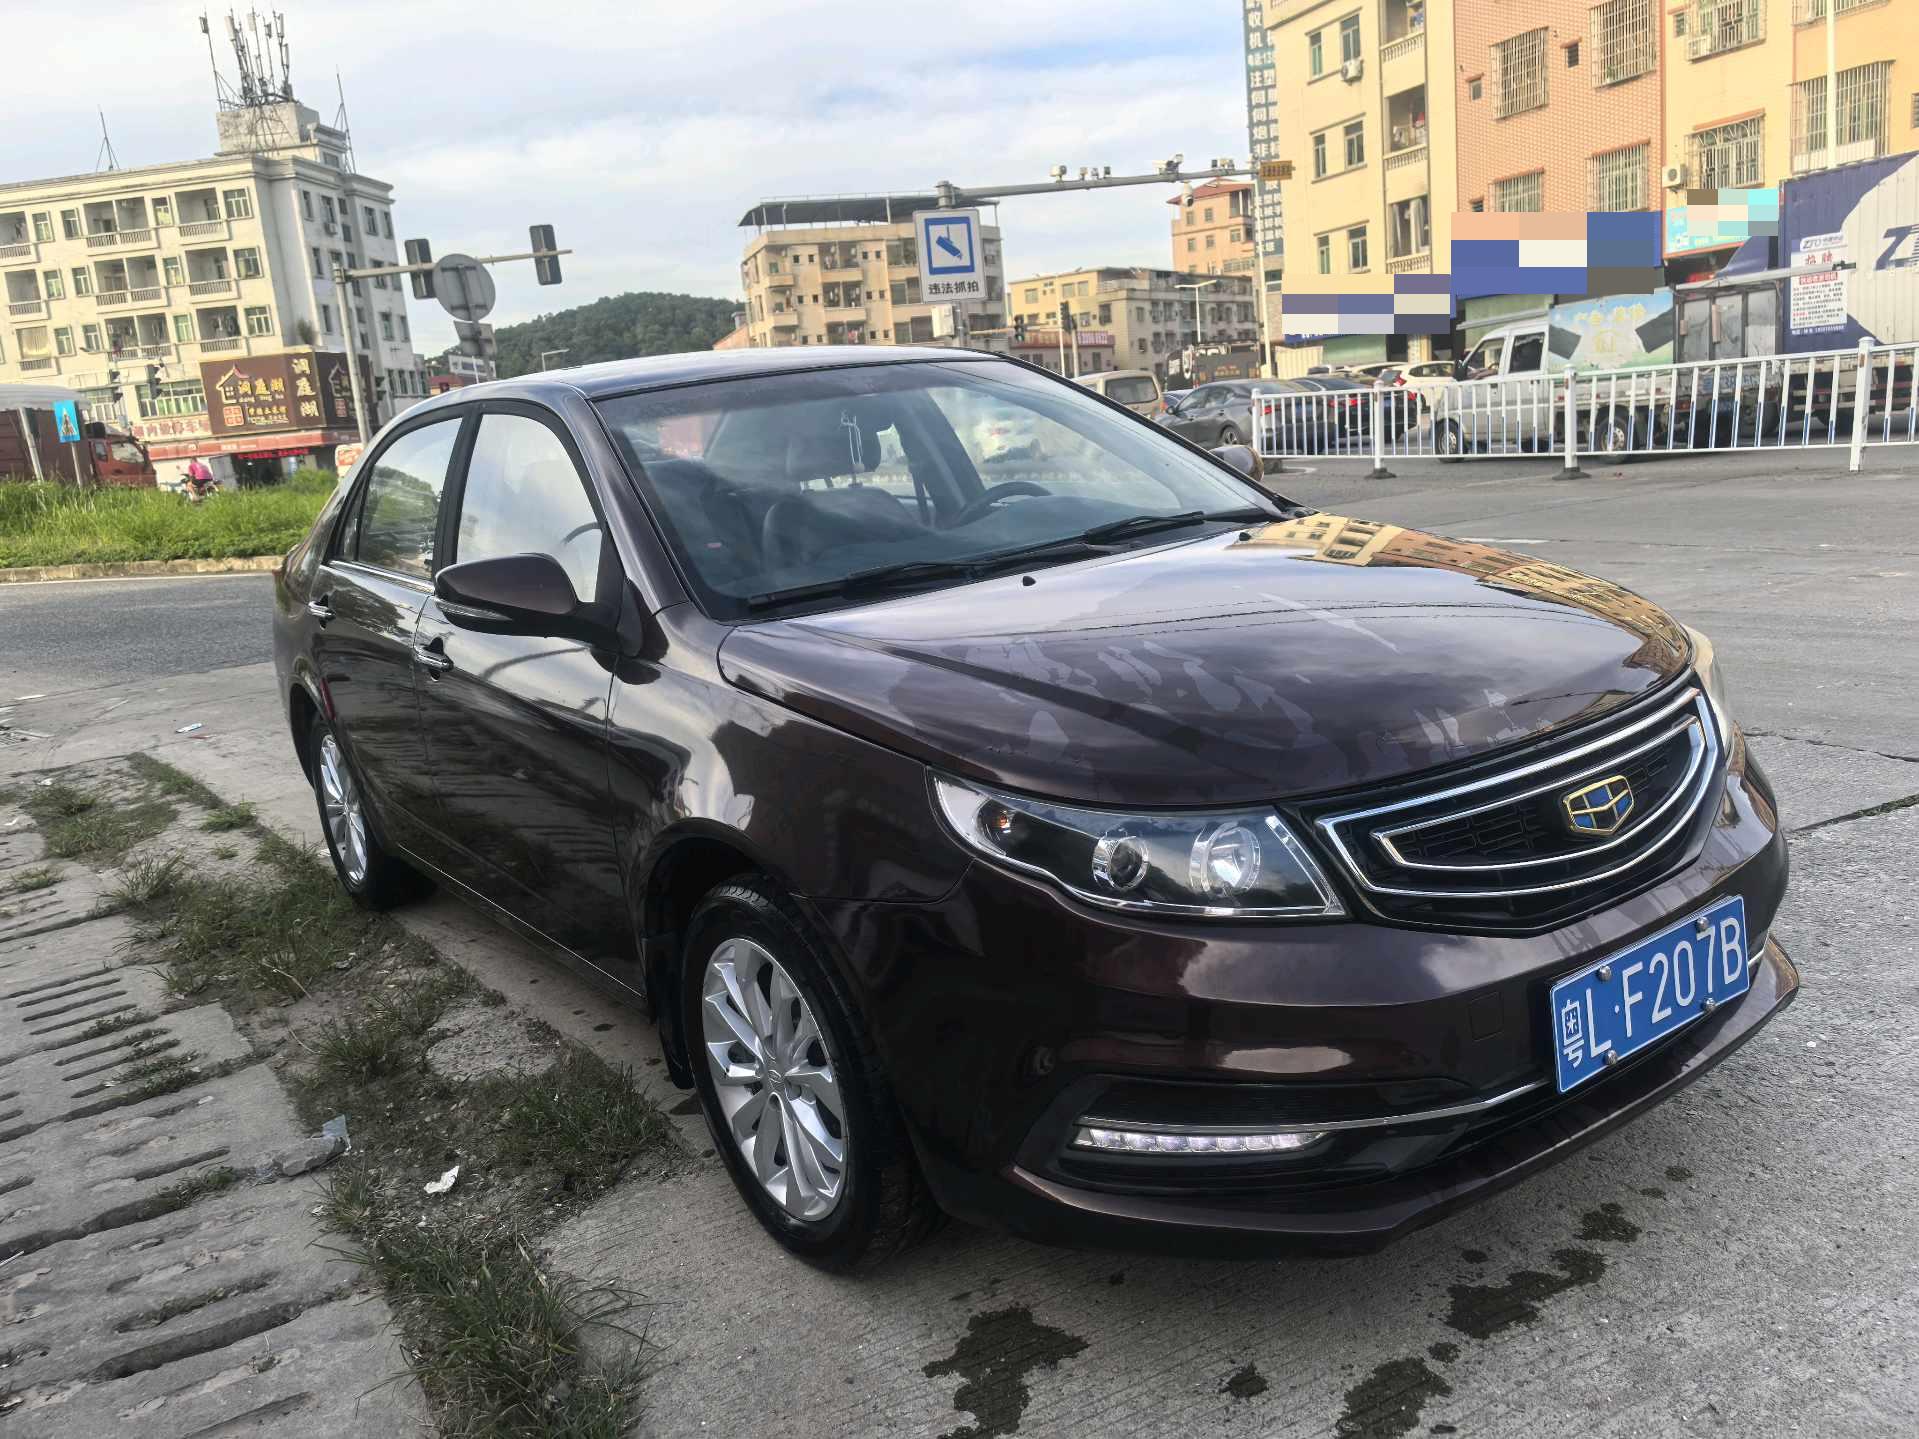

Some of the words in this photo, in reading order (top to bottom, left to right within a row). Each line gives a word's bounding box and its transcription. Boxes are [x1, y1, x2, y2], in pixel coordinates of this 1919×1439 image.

[928, 280, 979, 295] 违法抓拍
[291, 357, 320, 417] 洞庭湖
[1561, 917, 1743, 1068] 粤L·F207B
